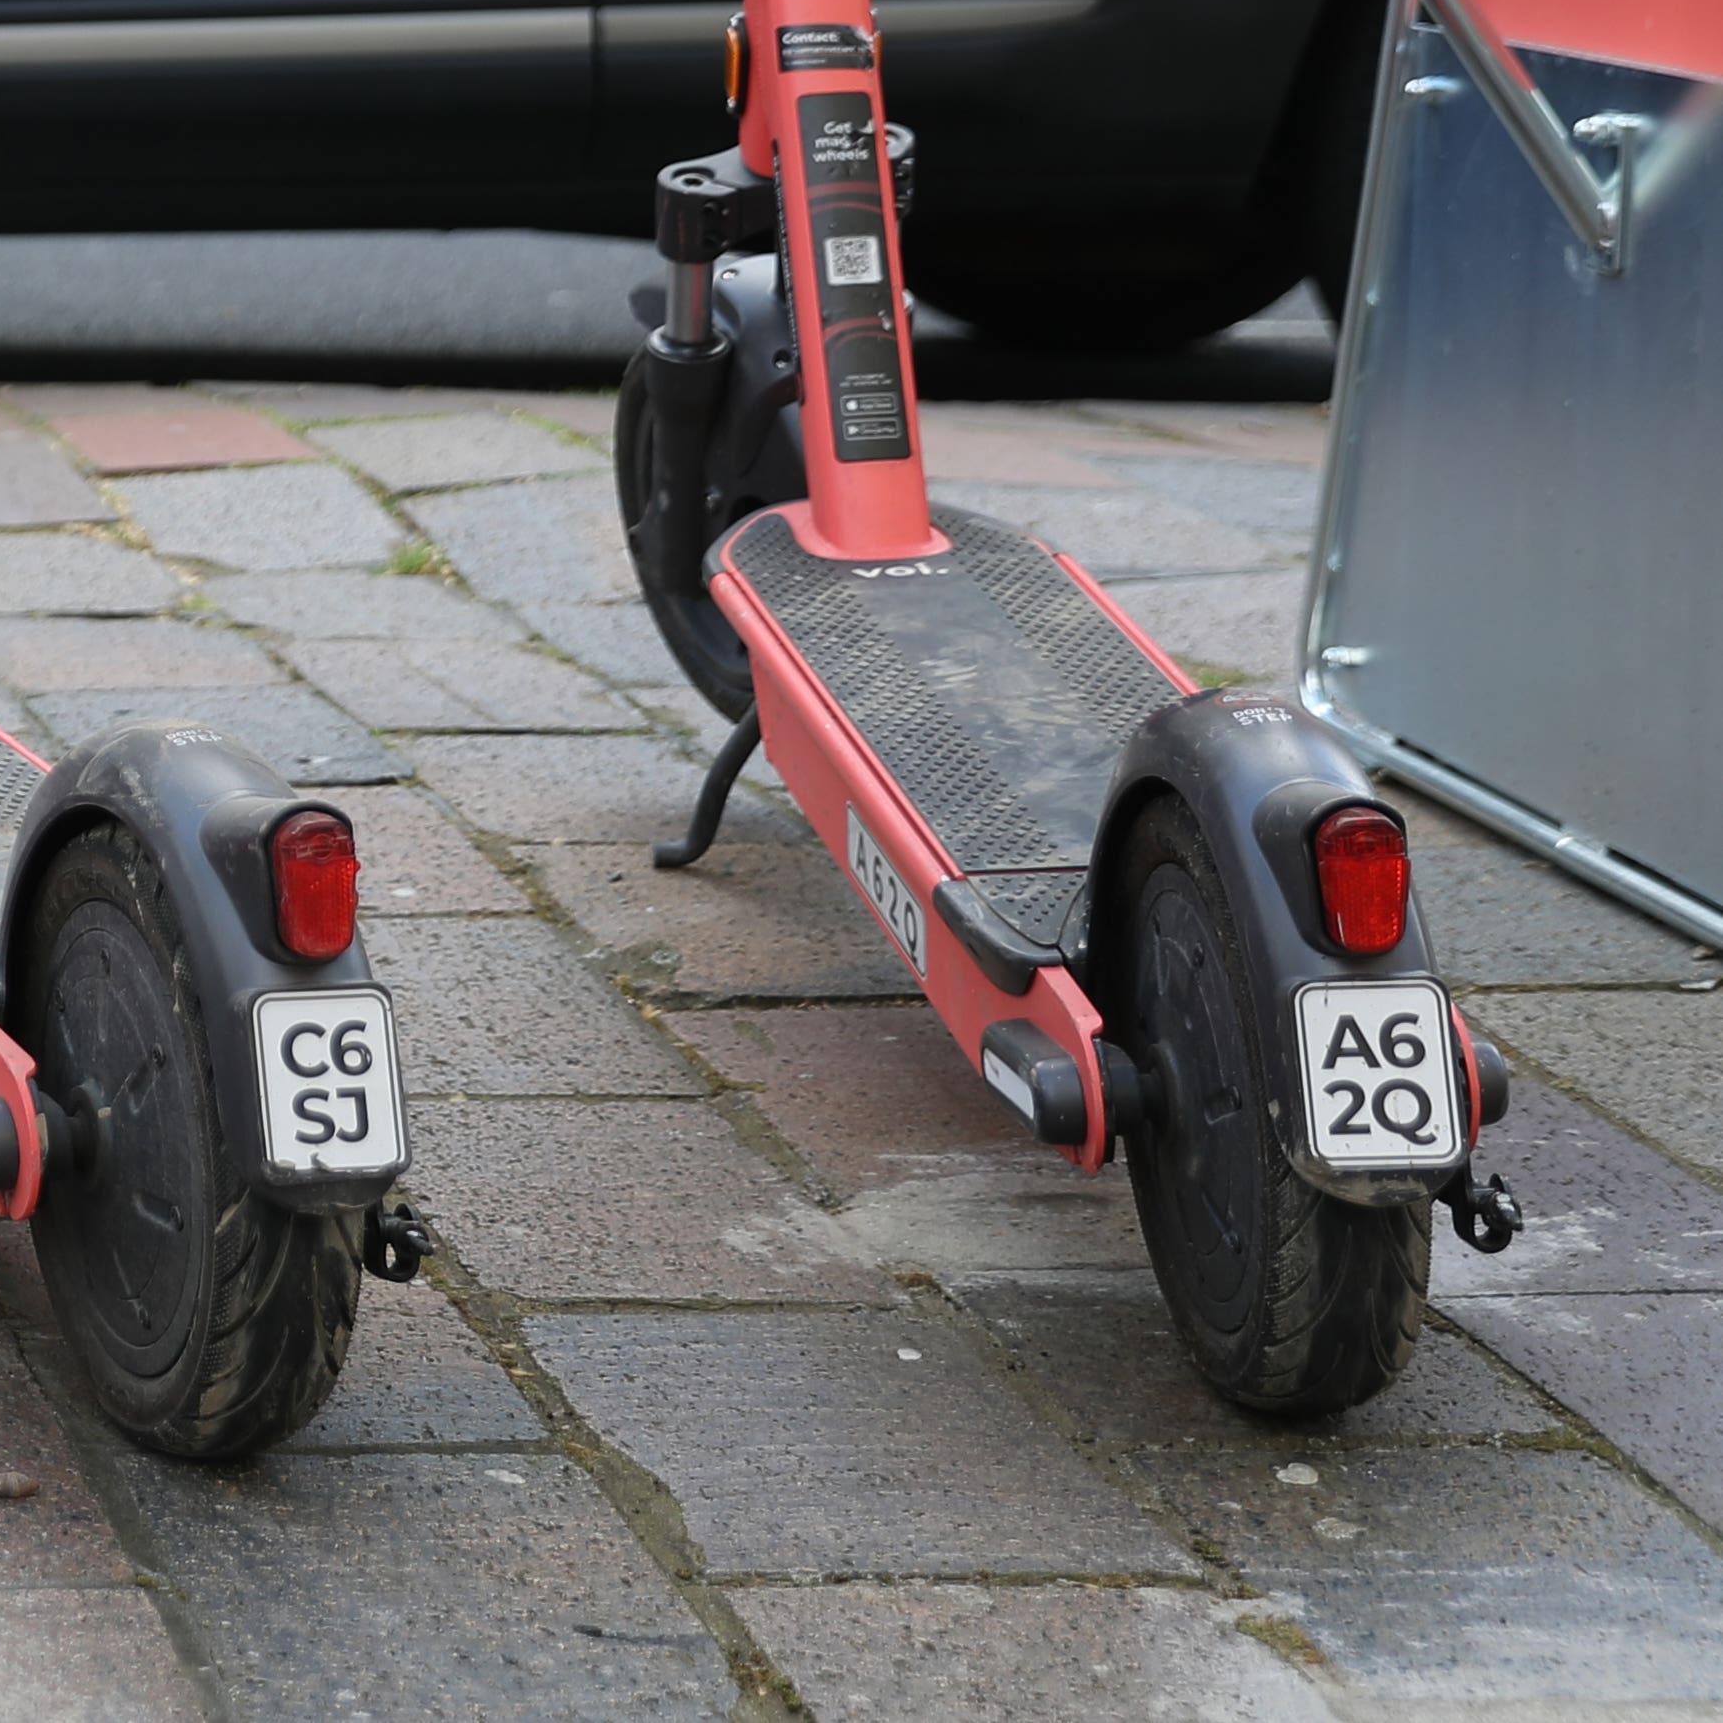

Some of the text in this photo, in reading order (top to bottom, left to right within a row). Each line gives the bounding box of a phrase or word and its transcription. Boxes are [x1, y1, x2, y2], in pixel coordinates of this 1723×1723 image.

[823, 121, 853, 134] Get
[813, 149, 869, 162] wheels
[851, 562, 950, 578] voi.
[1238, 713, 1293, 726] STEP
[280, 1019, 373, 1078] C6
[1321, 1012, 1426, 1069] A6
[292, 1086, 369, 1144] SJ
[1322, 1078, 1437, 1145] 2Q
